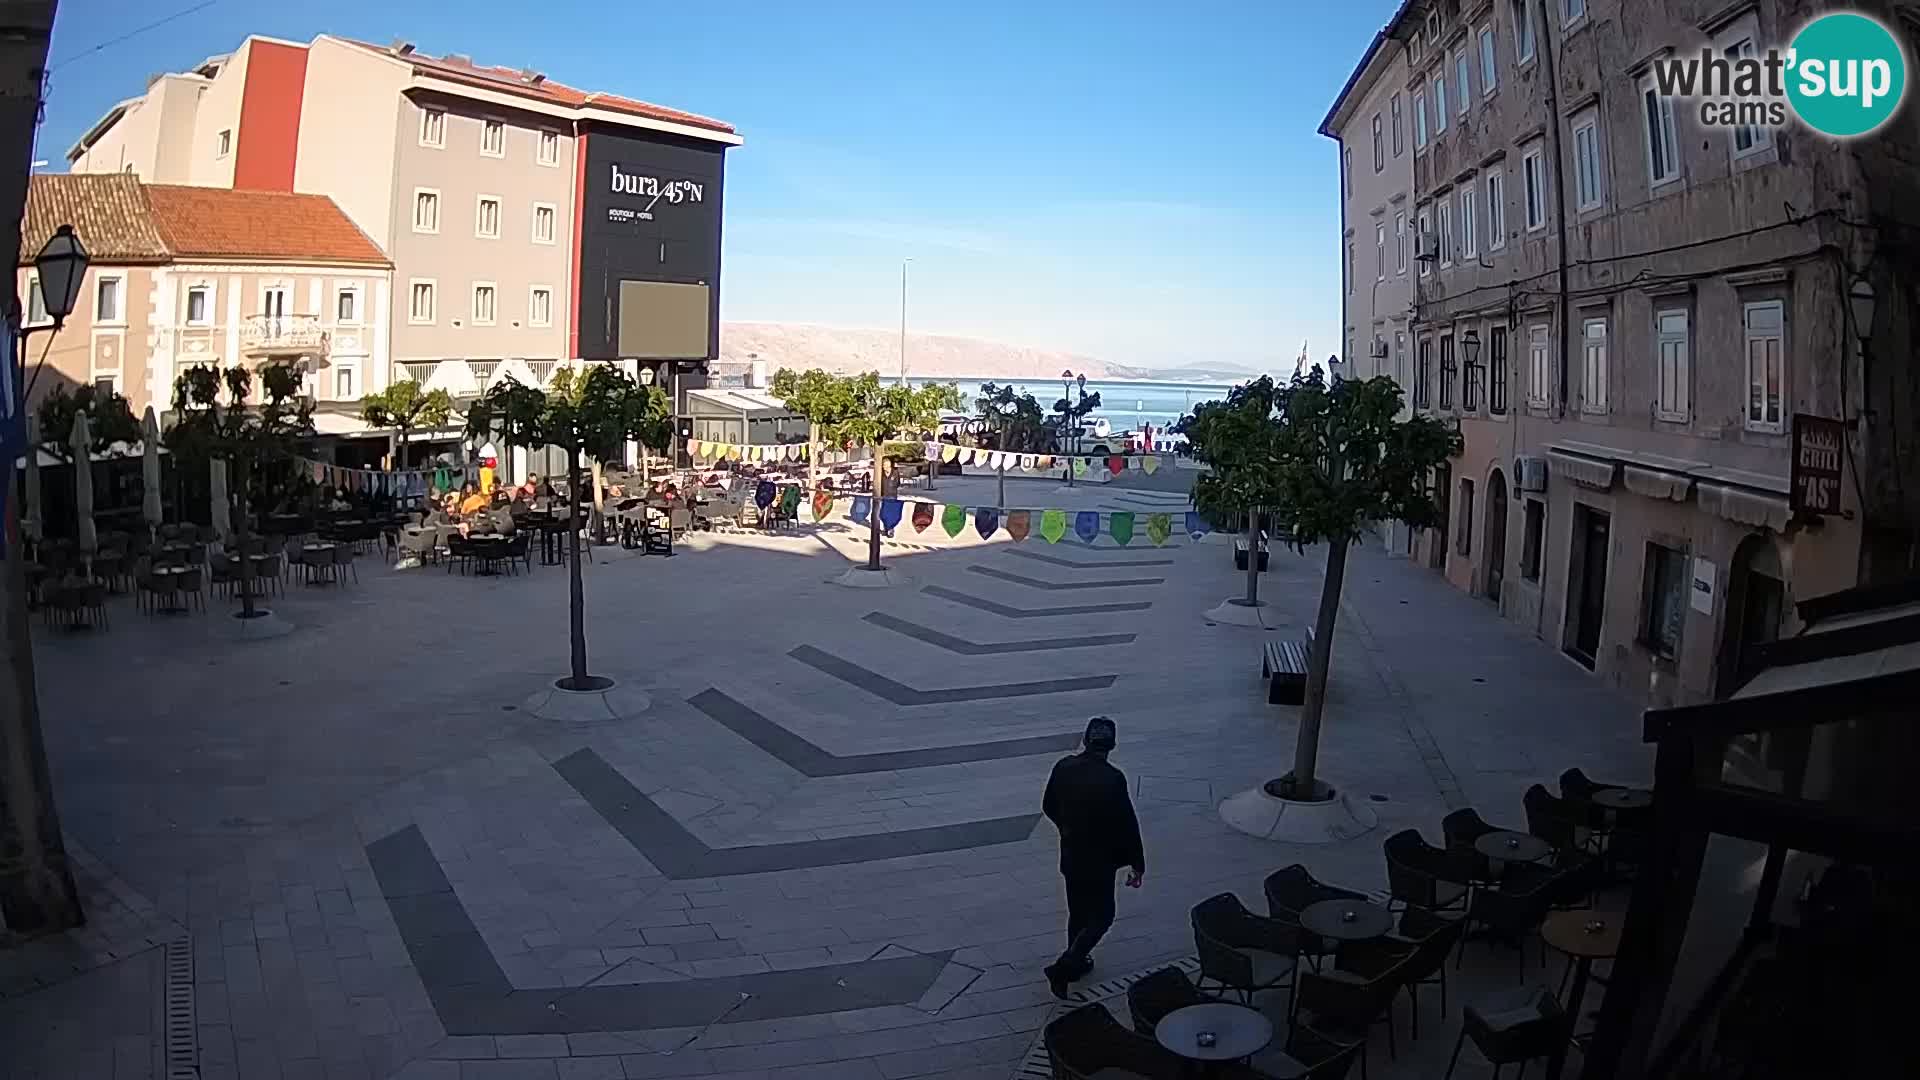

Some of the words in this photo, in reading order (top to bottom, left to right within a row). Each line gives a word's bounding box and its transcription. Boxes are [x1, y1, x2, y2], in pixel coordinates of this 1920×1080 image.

[611, 165, 658, 197] bura
[609, 209, 635, 218] BOUTIQUE
[637, 212, 653, 220] HOTEL
[1800, 447, 1840, 471] GRILL
